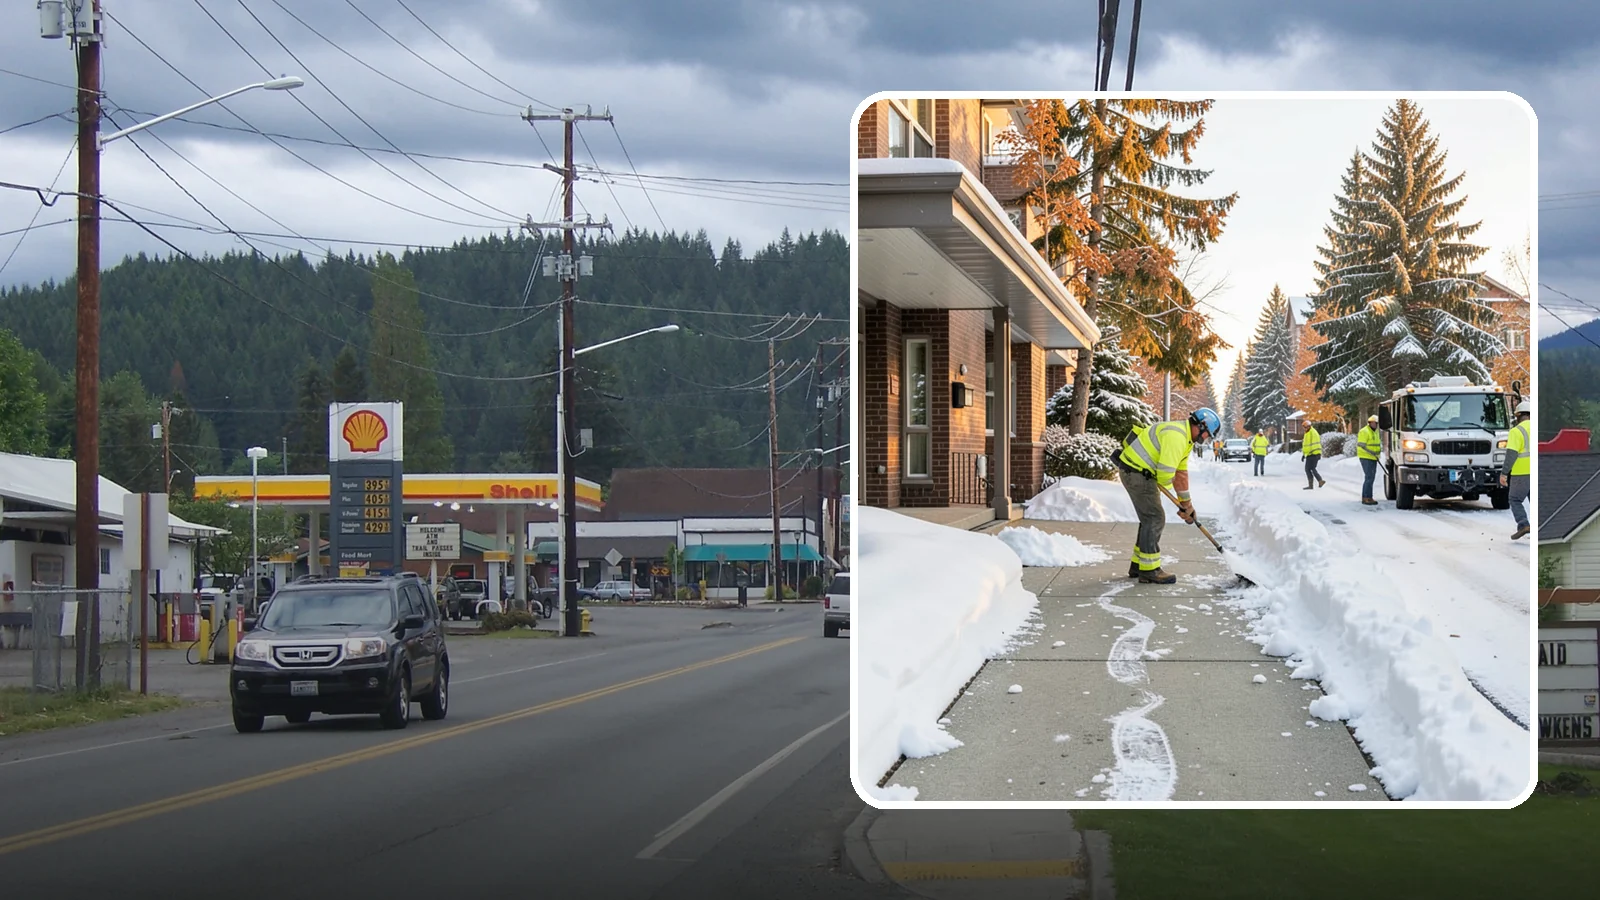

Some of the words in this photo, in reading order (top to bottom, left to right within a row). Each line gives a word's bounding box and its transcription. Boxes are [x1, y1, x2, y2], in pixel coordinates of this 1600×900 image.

[365, 480, 384, 490] 395
[490, 484, 547, 499] Shell
[365, 494, 384, 504] 405
[365, 508, 384, 518] 415
[365, 522, 384, 532] 429
